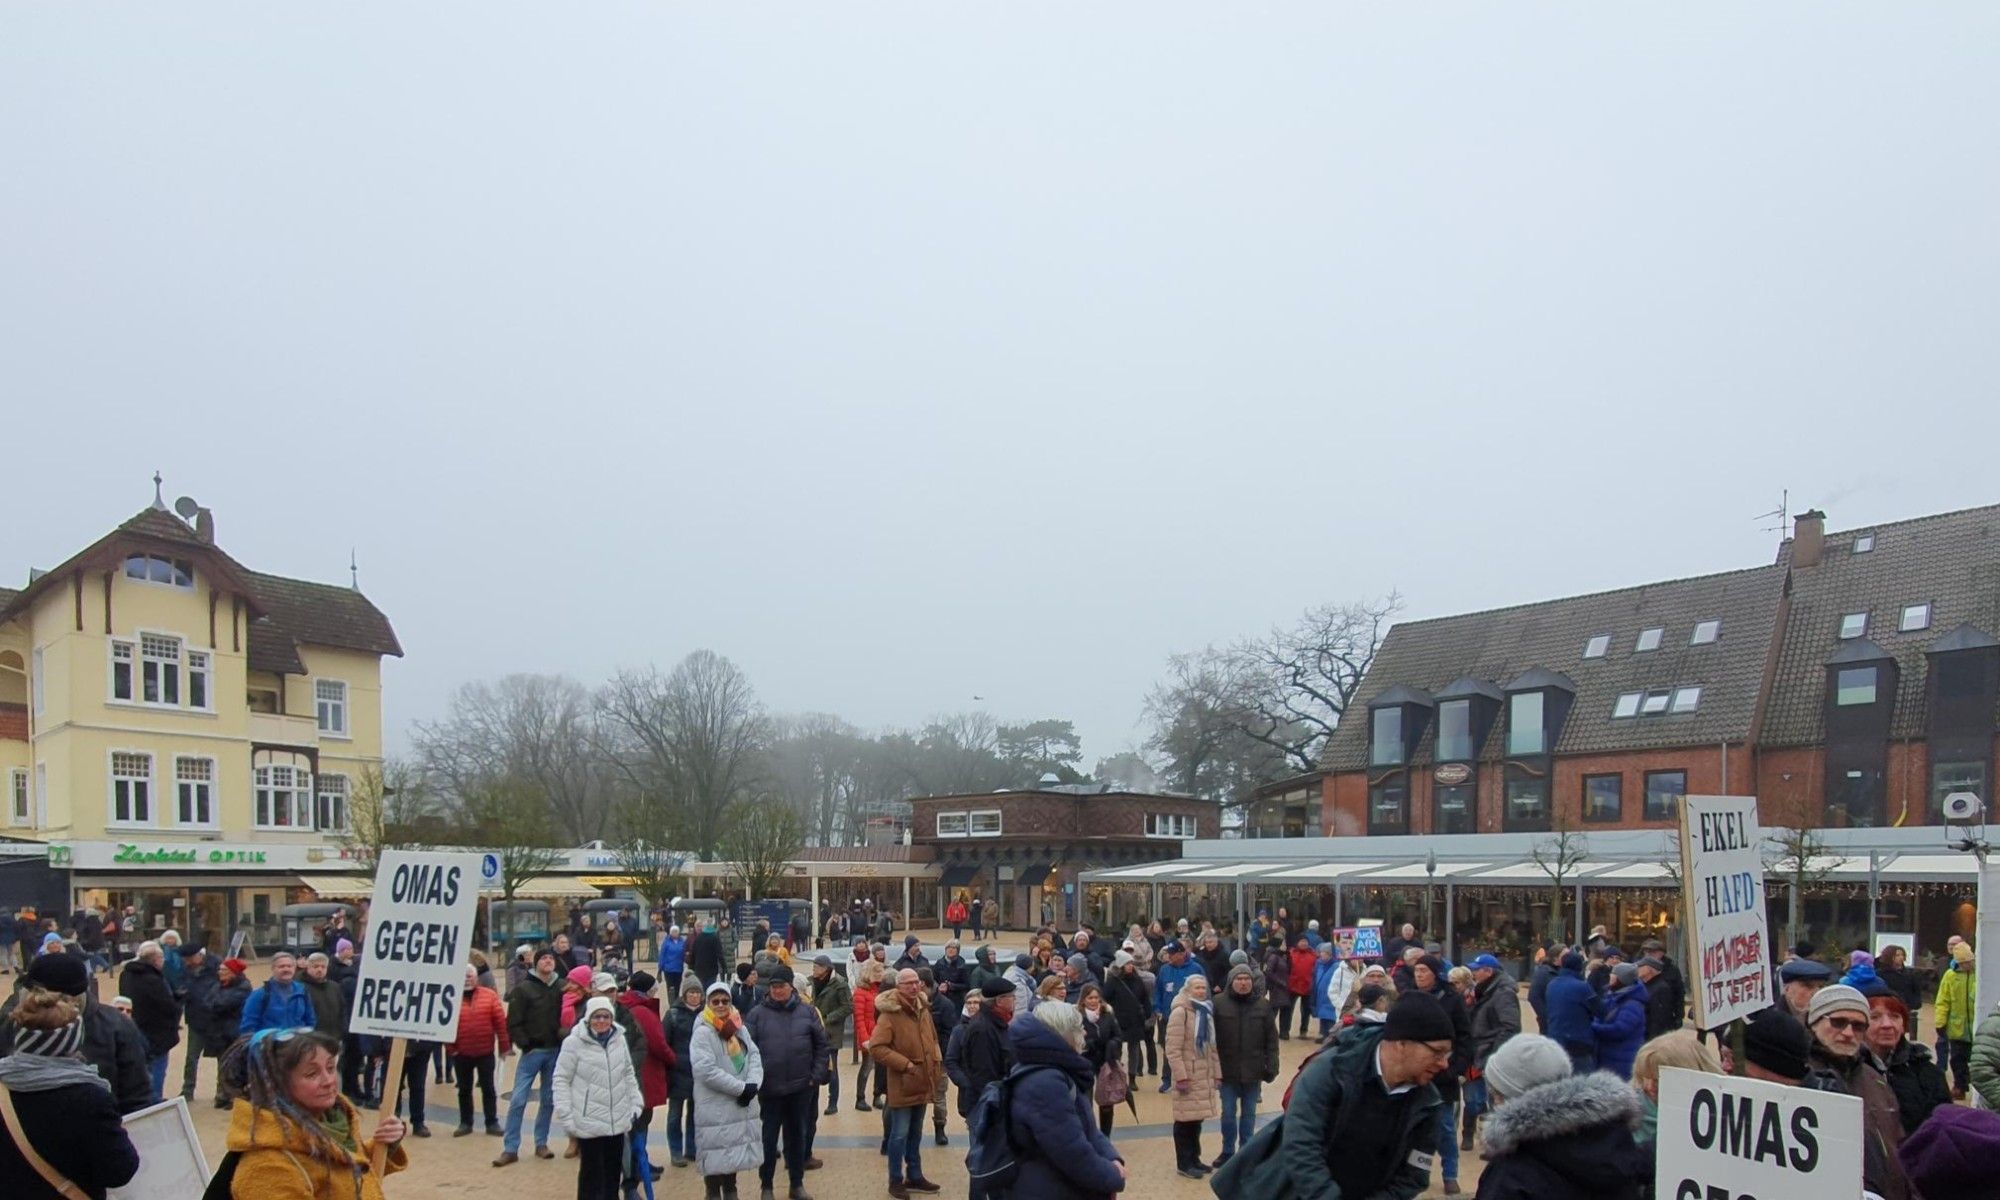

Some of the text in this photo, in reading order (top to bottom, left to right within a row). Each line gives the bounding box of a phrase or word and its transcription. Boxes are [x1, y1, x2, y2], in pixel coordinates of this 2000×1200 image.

[1701, 811, 1748, 852] EKEL
[392, 863, 461, 906] OMAS
[1705, 872, 1754, 917] HAFD
[375, 920, 459, 965] GEGEN
[358, 977, 455, 1026] RECHTS
[1707, 981, 1724, 1013] IST
[1690, 1088, 1819, 1173] OMAS
